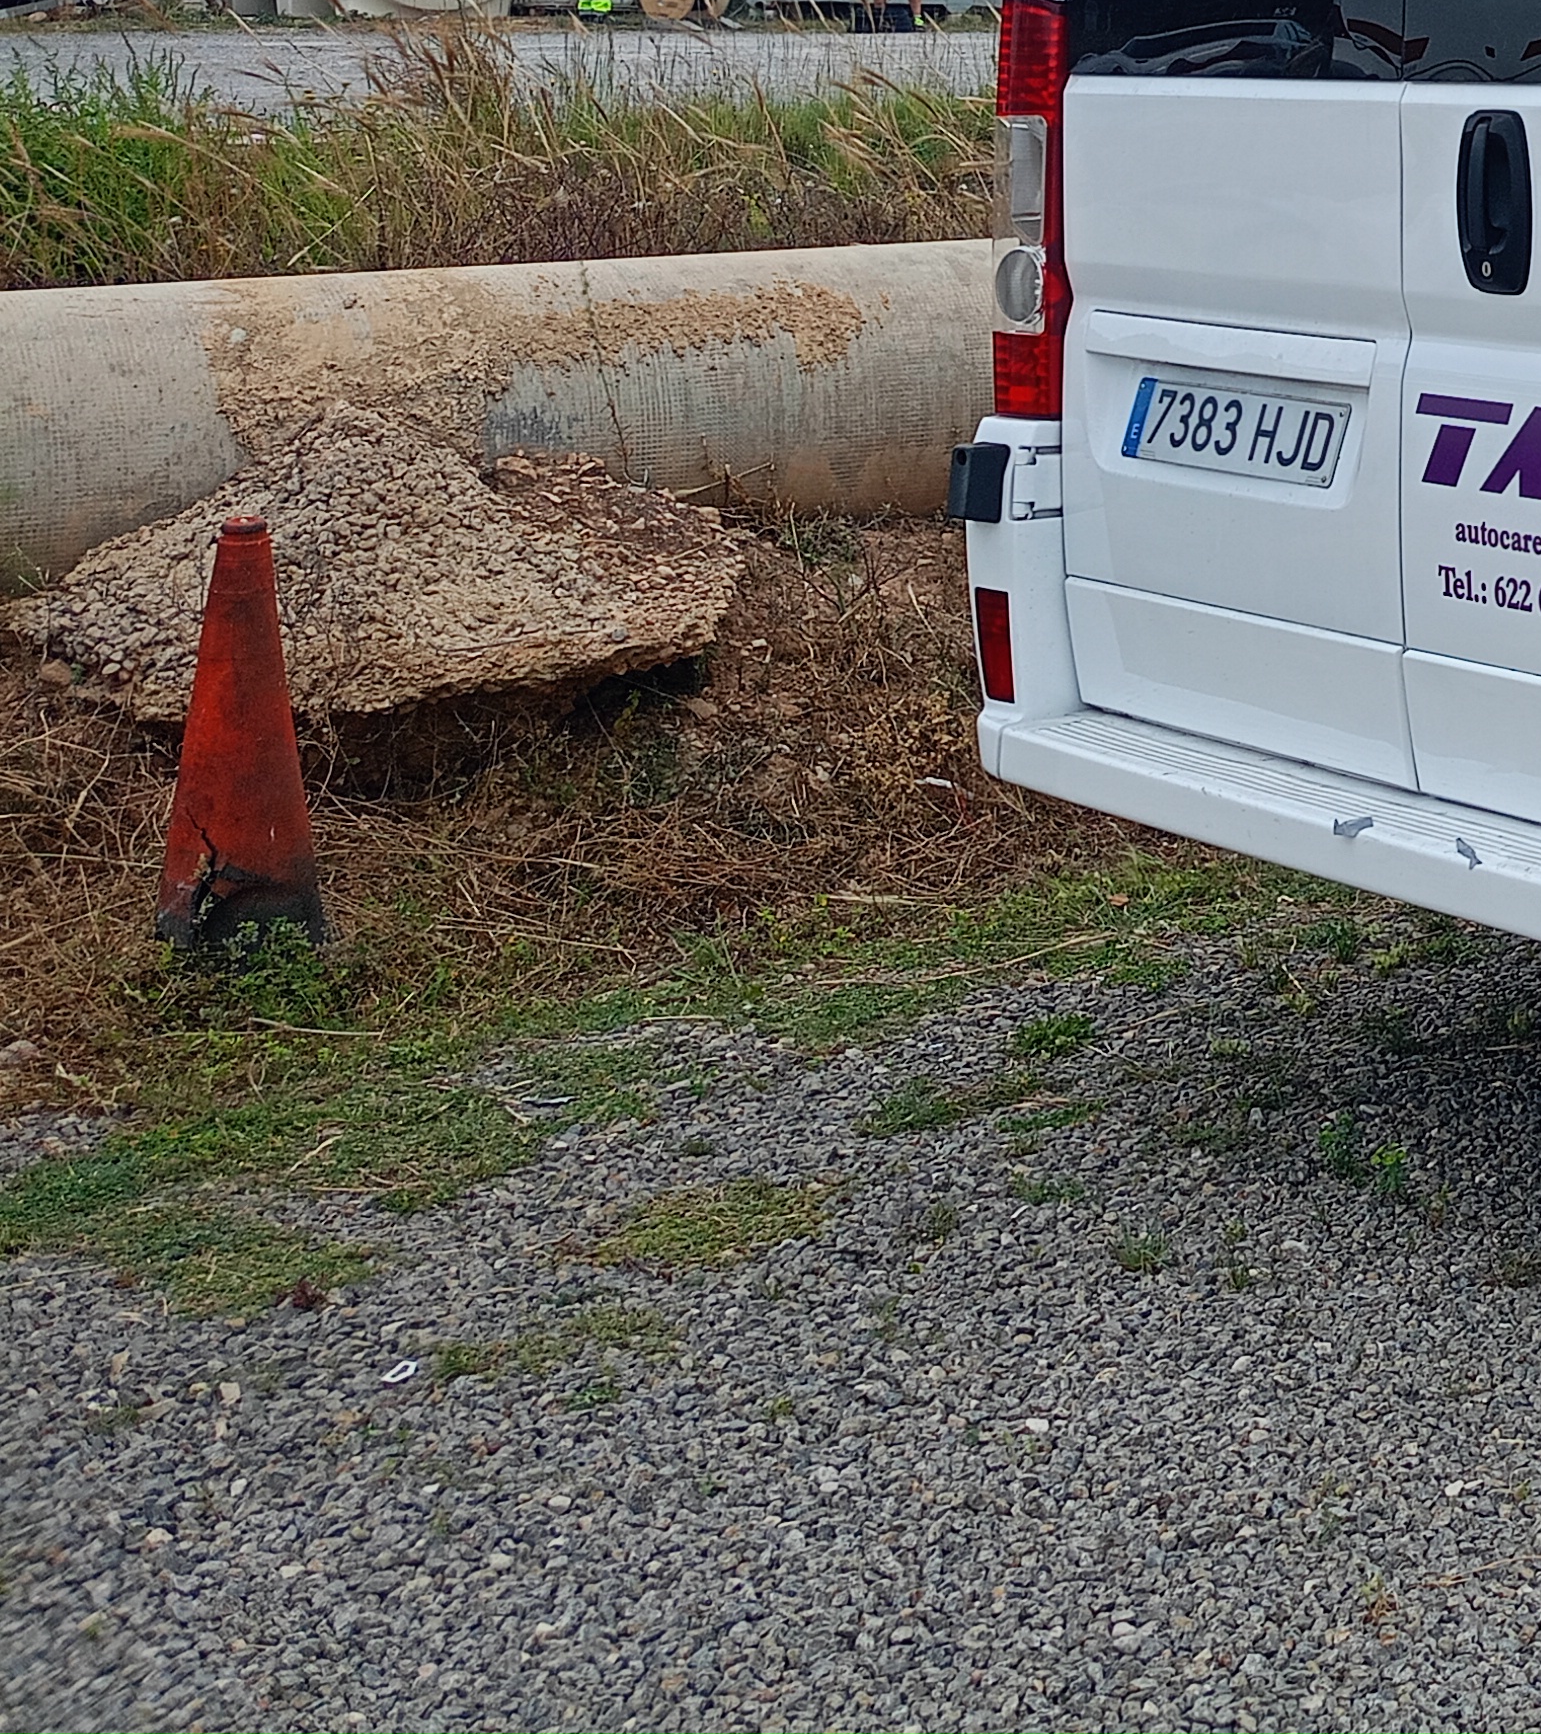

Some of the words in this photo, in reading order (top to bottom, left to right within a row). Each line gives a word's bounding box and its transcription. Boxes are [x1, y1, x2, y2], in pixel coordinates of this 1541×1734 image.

[1147, 389, 1242, 456] 7383
[1248, 403, 1335, 472] HJD
[1438, 565, 1487, 604] Tel.:
[1494, 576, 1532, 612] 622
